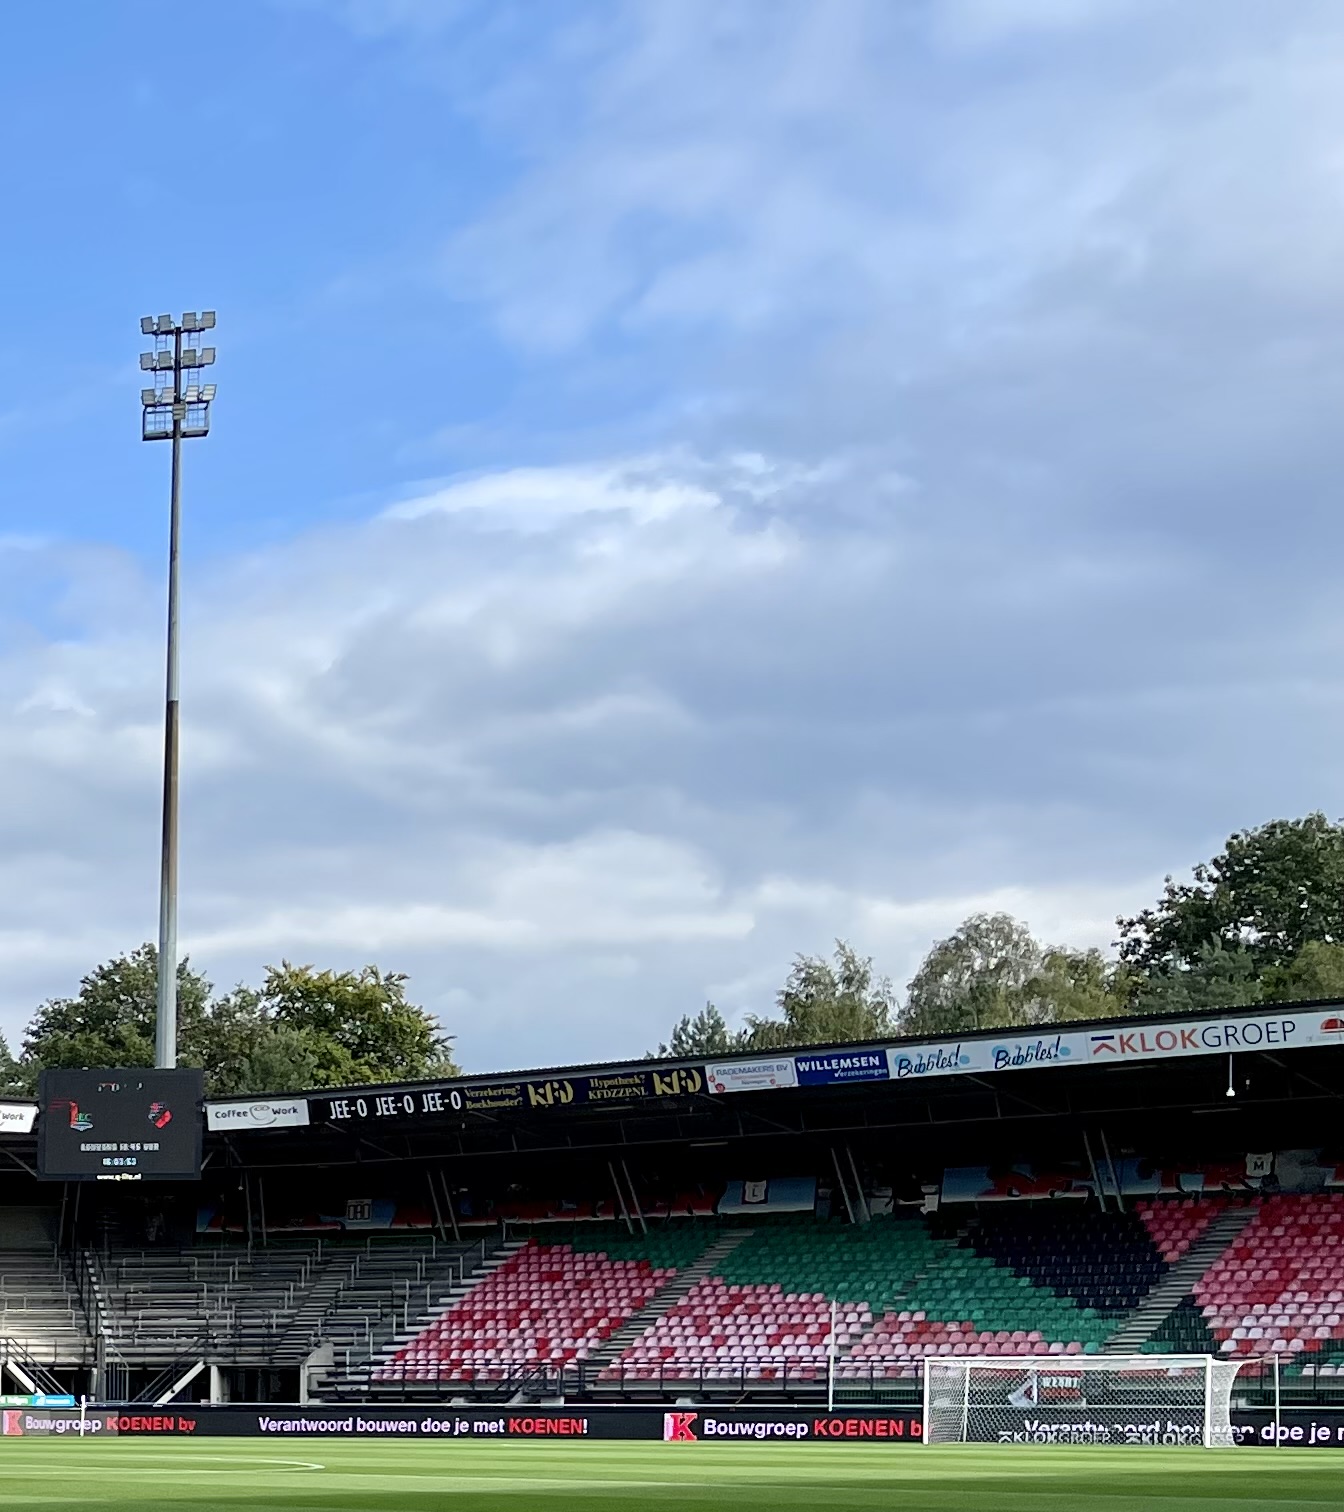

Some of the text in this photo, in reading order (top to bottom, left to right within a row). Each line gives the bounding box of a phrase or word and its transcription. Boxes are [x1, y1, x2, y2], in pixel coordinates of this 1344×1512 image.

[1119, 1020, 1296, 1055] KLOKGROEP
[796, 1055, 881, 1072] WILLEMSEN
[897, 1043, 961, 1078] Bubbles!
[994, 1035, 1061, 1070] Bubbles!
[716, 1063, 789, 1076] RADEMAKERS BV
[329, 1099, 368, 1120] JEE-O
[375, 1095, 415, 1117] JEE-O
[422, 1090, 463, 1113] JEE-O
[215, 1108, 249, 1119] Coffee
[25, 1415, 197, 1434] Bouwgroep KOENEN bv
[258, 1416, 589, 1436] Verantwoord bouwen doe je met KOENEN!
[703, 1418, 905, 1440] Bouwgroep KOENEN
[1261, 1421, 1305, 1442] doe
[1308, 1421, 1331, 1445] je
